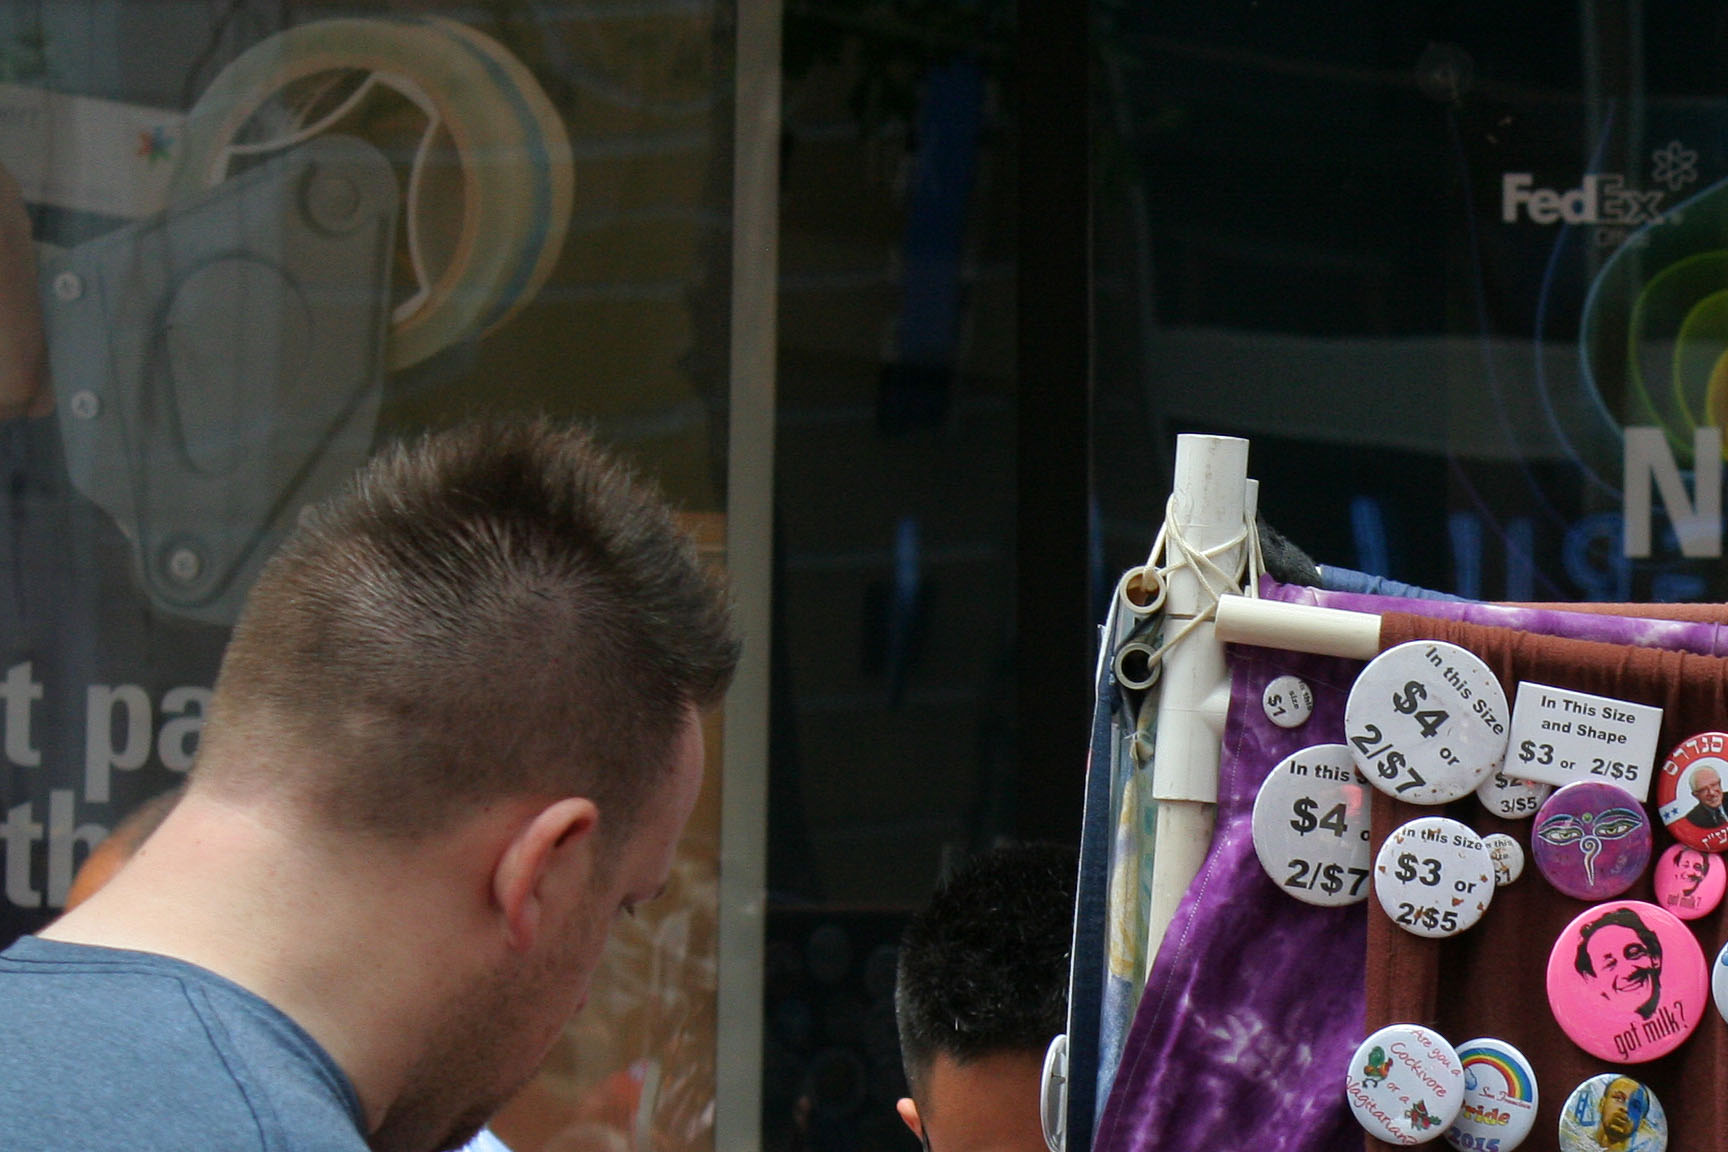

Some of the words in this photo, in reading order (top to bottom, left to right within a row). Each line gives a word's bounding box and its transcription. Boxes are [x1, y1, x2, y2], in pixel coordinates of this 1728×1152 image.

[1502, 173, 1656, 224] FedEx
[1267, 694, 1287, 716] $1
[1393, 680, 1449, 738] $4
[1425, 647, 1442, 667] In
[1442, 667, 1472, 700] this
[1472, 699, 1504, 735] Size
[1541, 696, 1556, 708] In
[1563, 699, 1597, 717] This
[1602, 707, 1636, 724] Size
[1541, 718, 1571, 734] and
[1576, 724, 1627, 745] Shape
[1290, 760, 1308, 776] In
[1314, 762, 1350, 782] this
[1351, 723, 1426, 793] 2/$7
[1439, 747, 1460, 766] or
[1519, 739, 1554, 766] $3
[1560, 758, 1576, 770] or
[1591, 758, 1638, 782] 2/$5
[1290, 796, 1348, 838] $4
[1501, 796, 1537, 813] 3/$5
[1402, 826, 1416, 839] In
[1420, 828, 1449, 844] this
[1452, 834, 1483, 850] Size
[1284, 858, 1370, 896] 2/$7
[1394, 852, 1442, 886] $3
[1454, 879, 1477, 894] or
[1397, 902, 1458, 932] 2/$5
[1613, 1026, 1641, 1060] got
[1642, 1001, 1690, 1044] milk?
[1390, 1041, 1447, 1098] Cockivore
